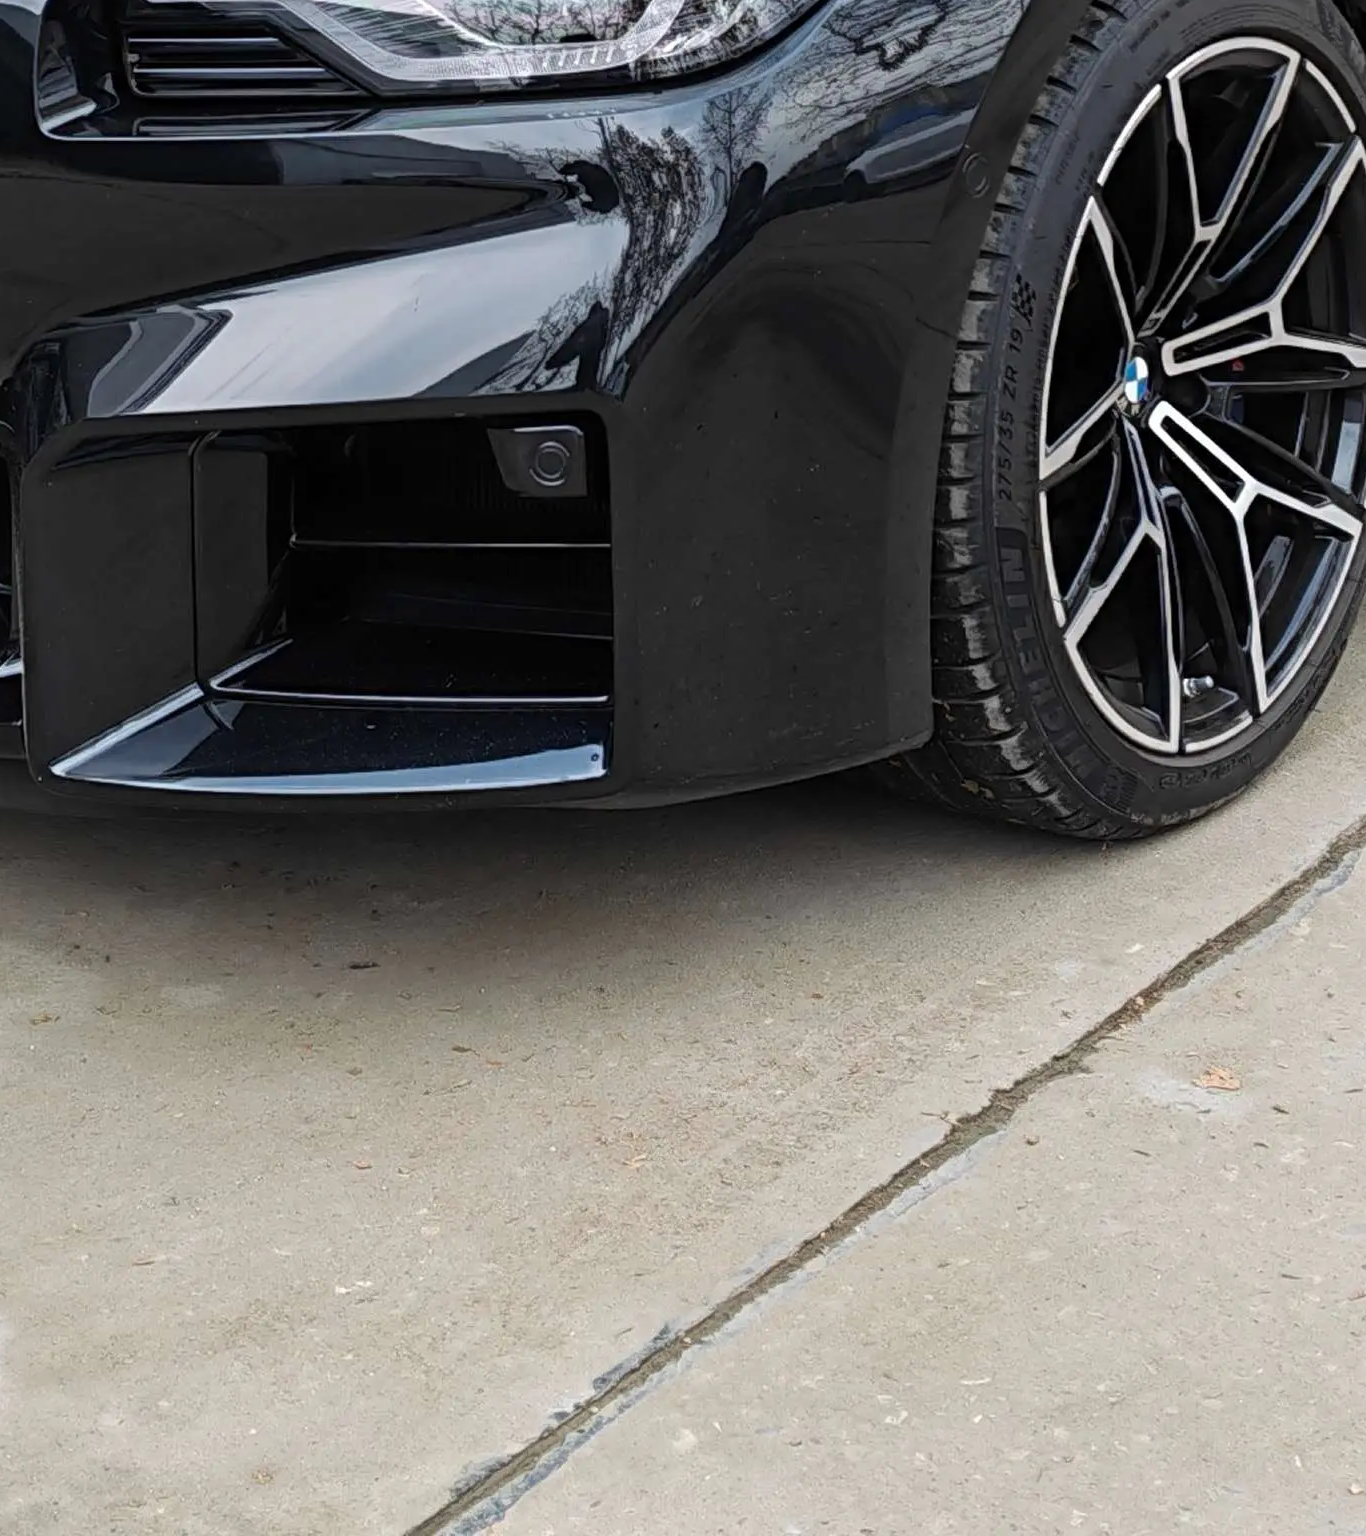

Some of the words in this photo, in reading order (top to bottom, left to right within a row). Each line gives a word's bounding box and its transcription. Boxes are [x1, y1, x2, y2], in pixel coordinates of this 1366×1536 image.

[1008, 328, 1025, 354] 19
[1001, 366, 1019, 401] ZR
[998, 411, 1018, 502] 275/35
[999, 546, 1095, 779] MICHELIN
